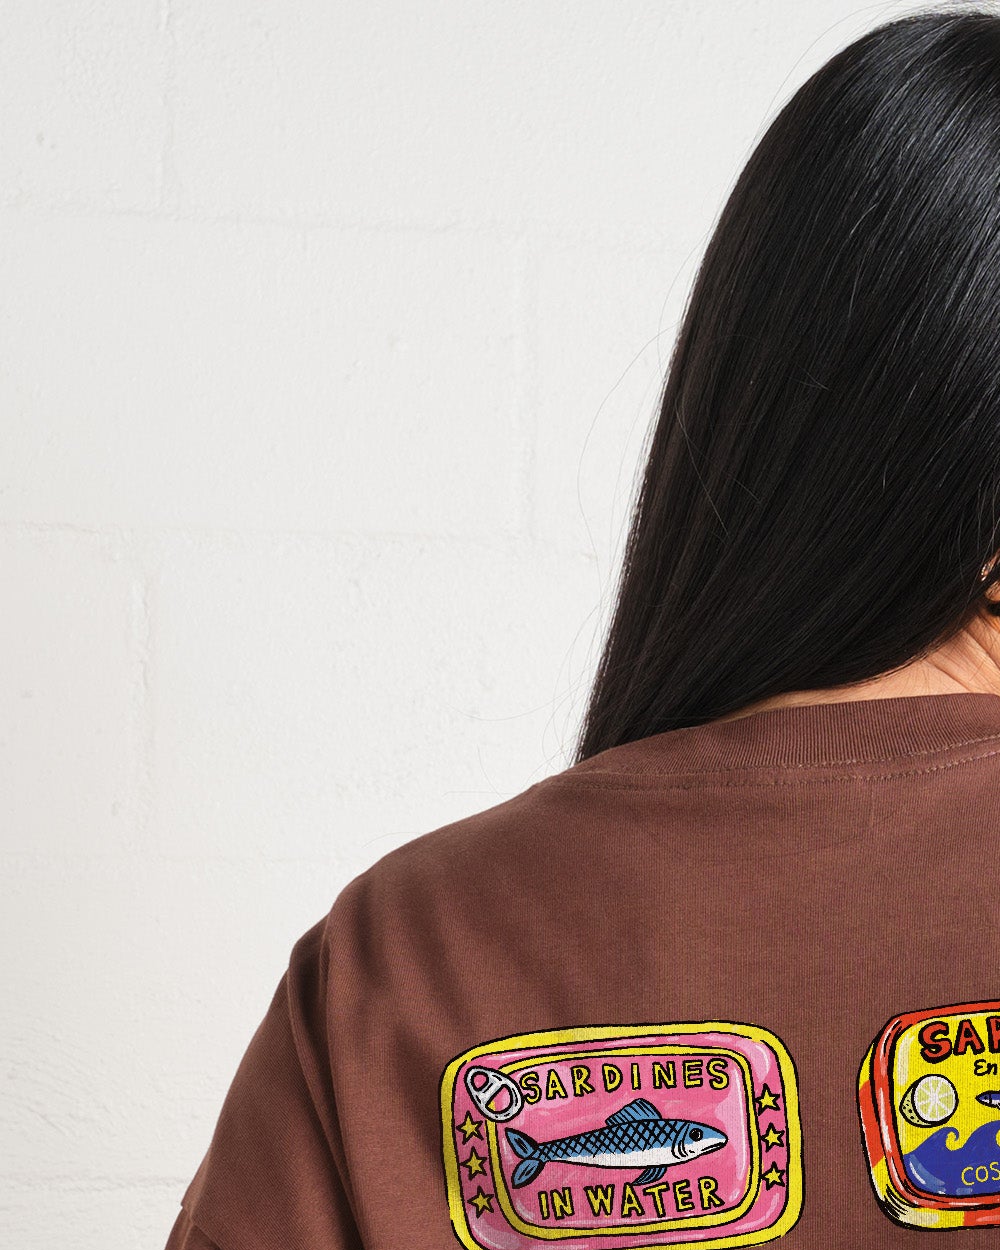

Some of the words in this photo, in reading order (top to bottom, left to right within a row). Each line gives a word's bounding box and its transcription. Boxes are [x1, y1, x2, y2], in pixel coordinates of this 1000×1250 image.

[520, 1058, 730, 1104] SARDINES
[973, 1059, 998, 1077] En
[538, 1186, 575, 1220] IN
[586, 1176, 726, 1220] WATER
